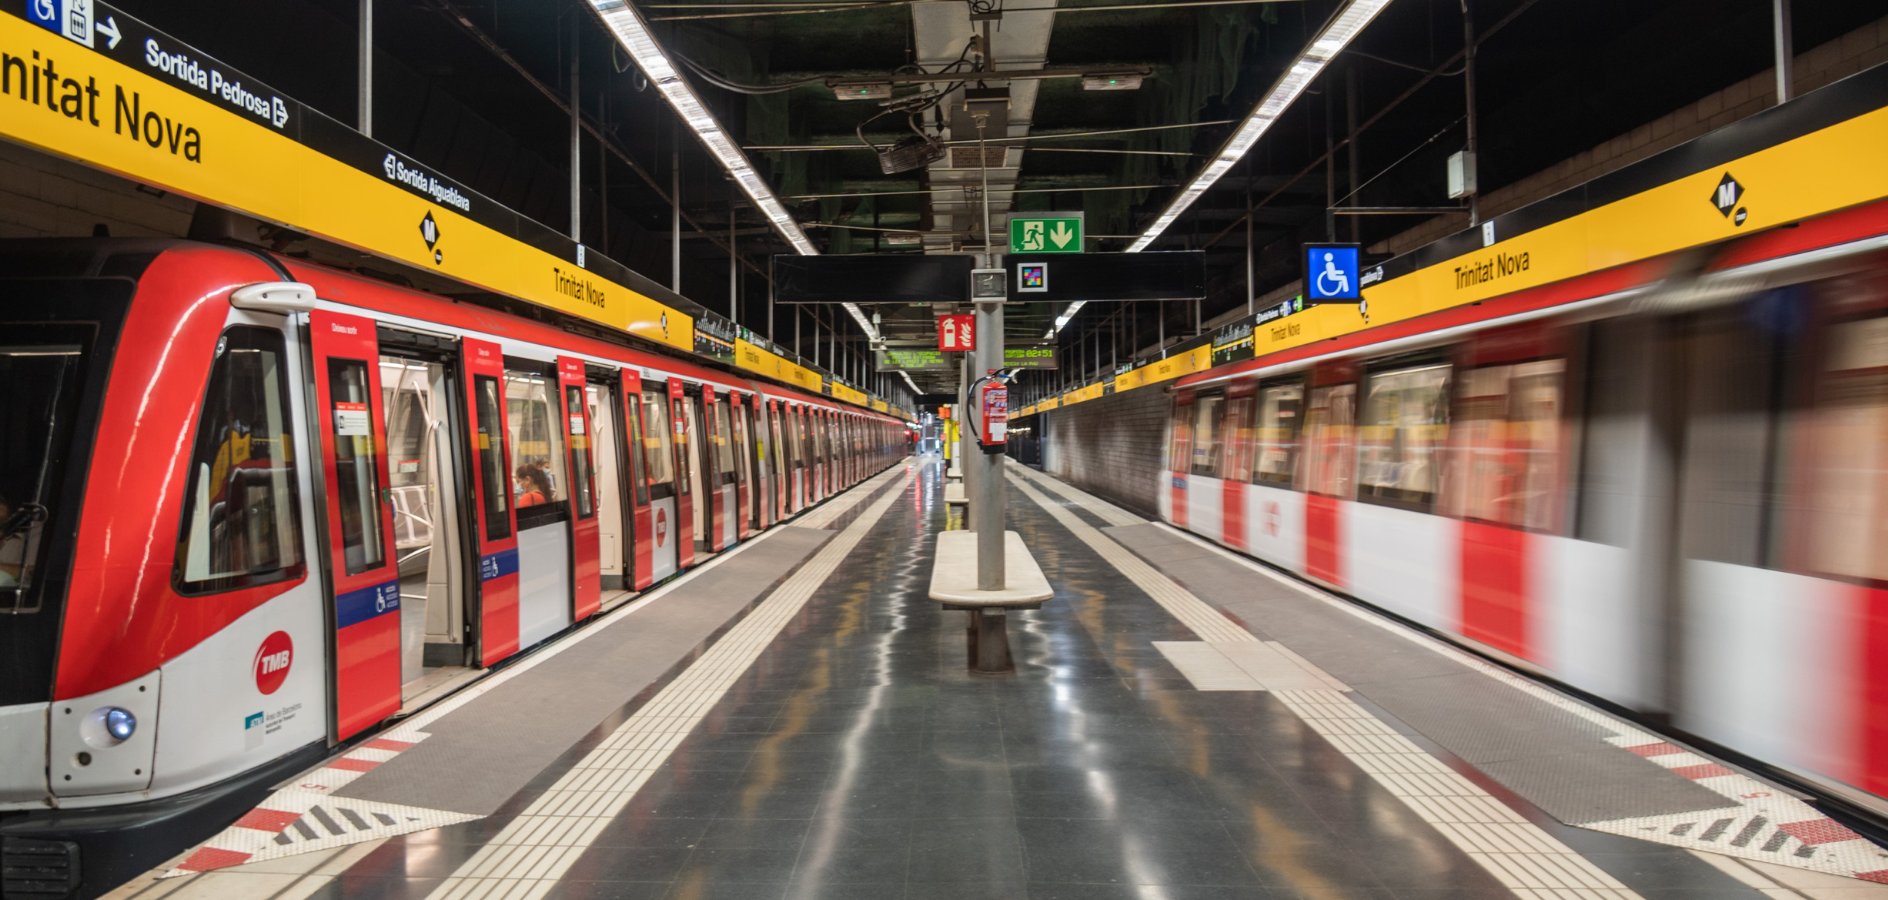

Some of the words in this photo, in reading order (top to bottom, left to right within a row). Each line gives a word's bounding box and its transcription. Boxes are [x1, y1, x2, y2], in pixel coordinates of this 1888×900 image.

[146, 39, 208, 90] Sortida
[210, 70, 271, 120] Pedrosa
[115, 84, 201, 164] Nova
[396, 161, 428, 192] Sortida
[428, 177, 470, 211] Aiguablava
[1718, 181, 1736, 209] M
[424, 218, 436, 243] M
[553, 267, 584, 301] Trinitat
[586, 280, 605, 308] Nova
[1454, 257, 1494, 290] Trinitat
[1497, 251, 1530, 279] Nova
[1026, 349, 1053, 358] 02:51
[262, 649, 290, 675] TMB
